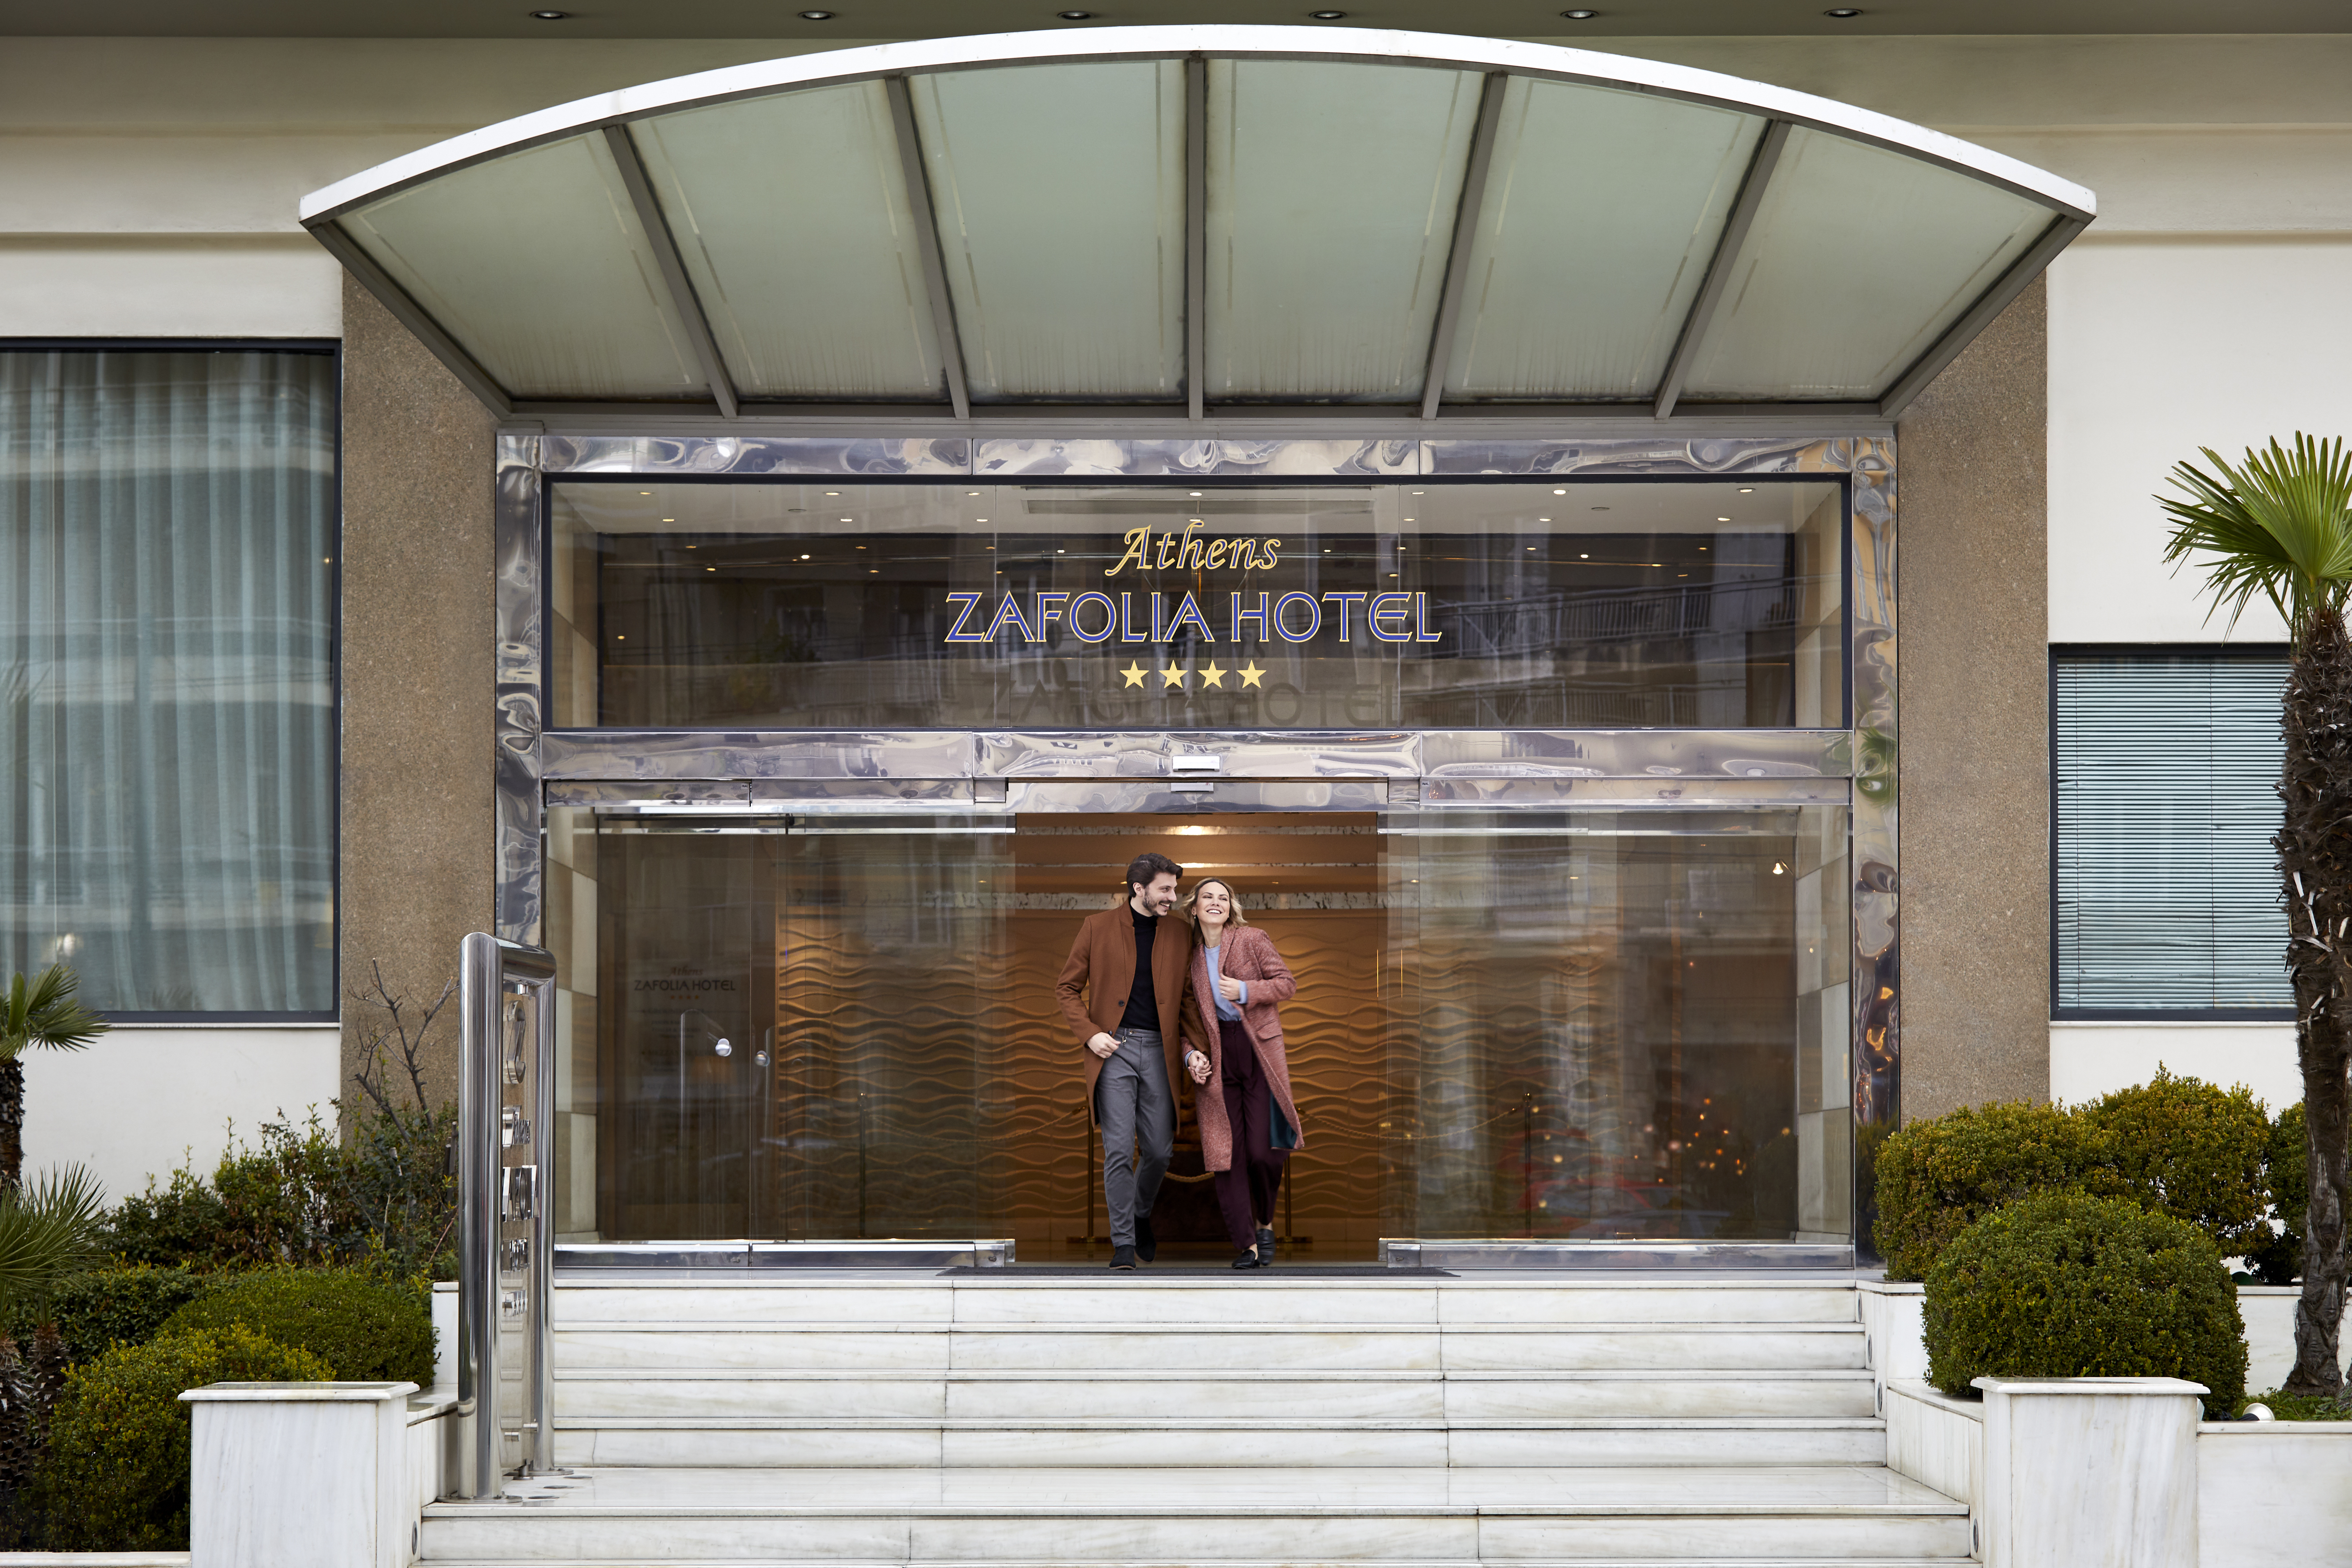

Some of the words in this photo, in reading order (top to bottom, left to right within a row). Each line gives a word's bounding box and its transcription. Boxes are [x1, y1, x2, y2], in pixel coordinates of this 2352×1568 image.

[1105, 519, 1281, 576] Athens
[944, 590, 1215, 643] ZAFOLIA
[1231, 591, 1442, 643] HOTEL
[634, 980, 689, 991] ZAFOLIA
[692, 980, 735, 991] HOTEL
[669, 966, 704, 976] Athens
